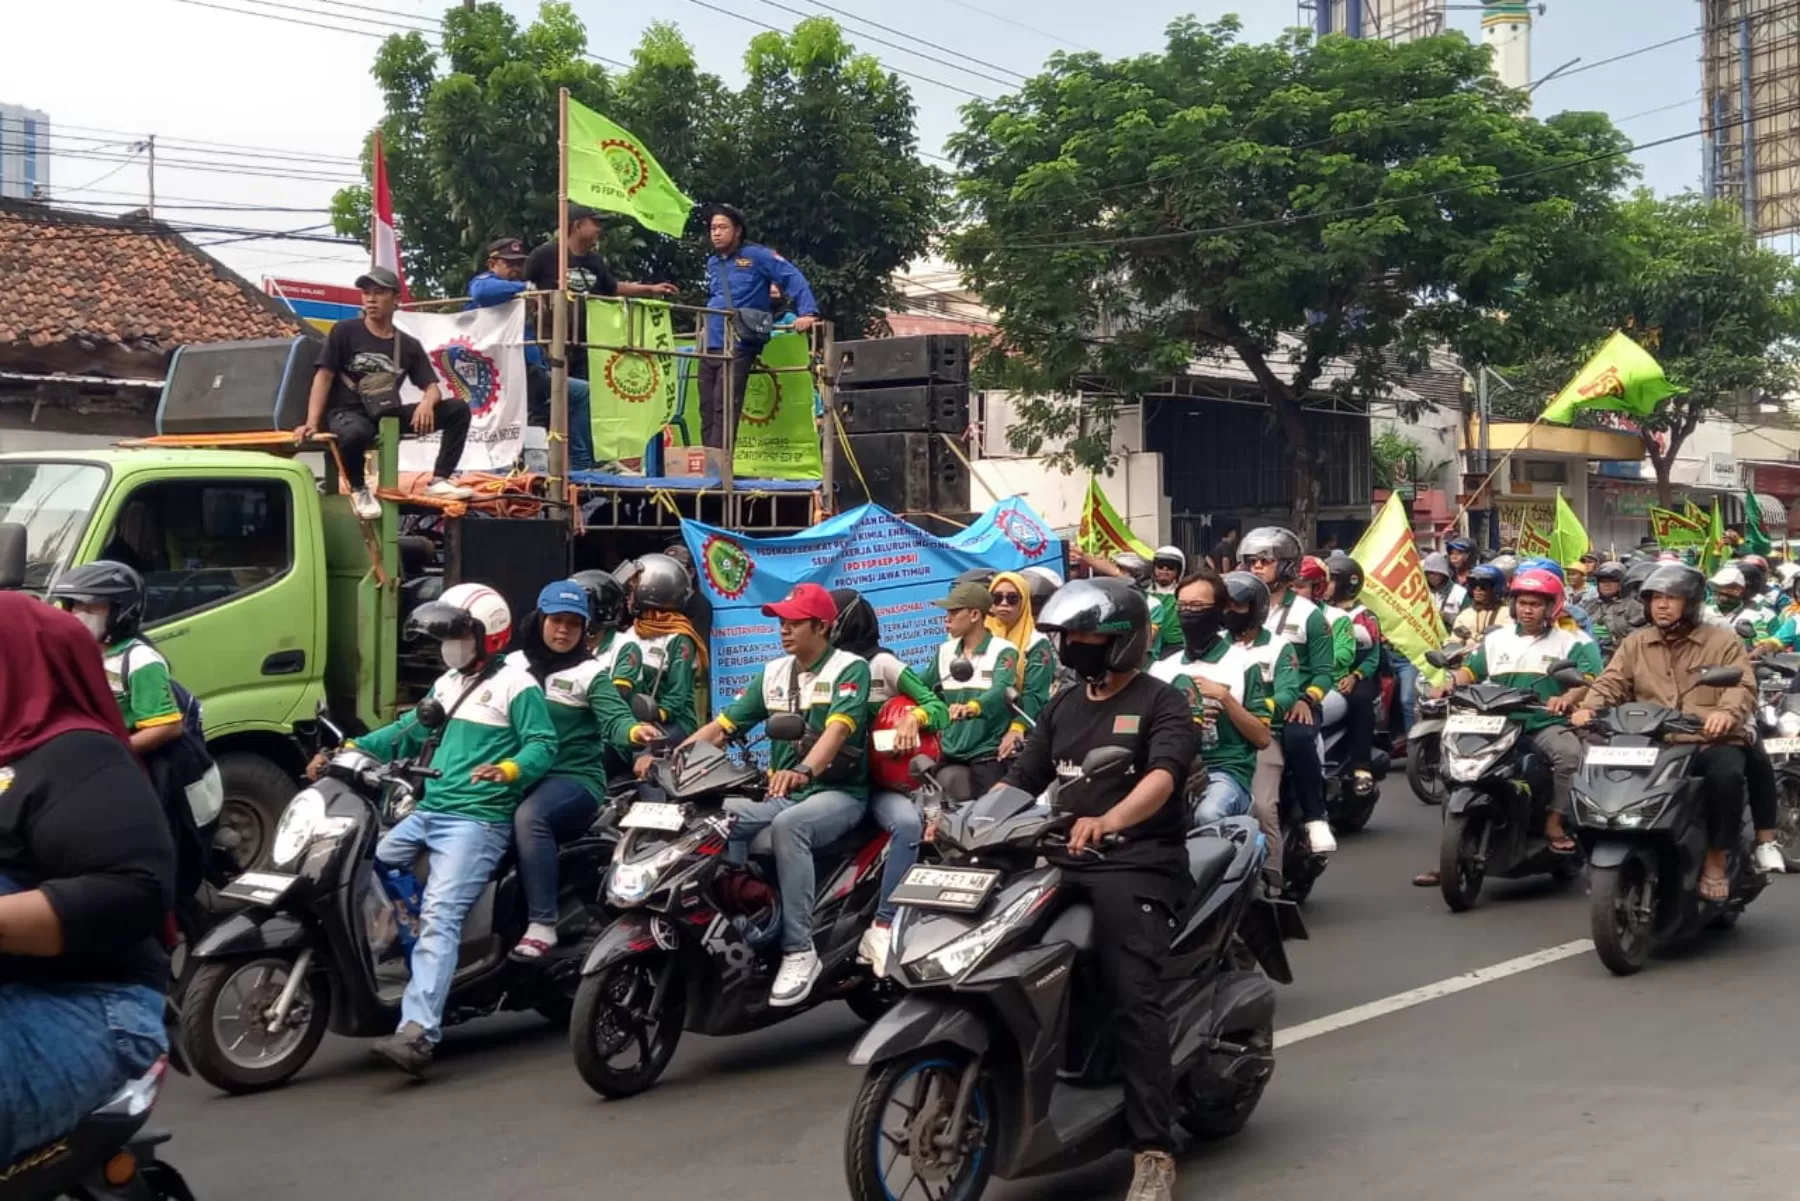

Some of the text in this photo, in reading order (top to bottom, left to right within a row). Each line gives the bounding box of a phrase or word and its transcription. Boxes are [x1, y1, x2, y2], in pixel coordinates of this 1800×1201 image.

[835, 565, 930, 587] PROVINSI JAWA TIMUR
